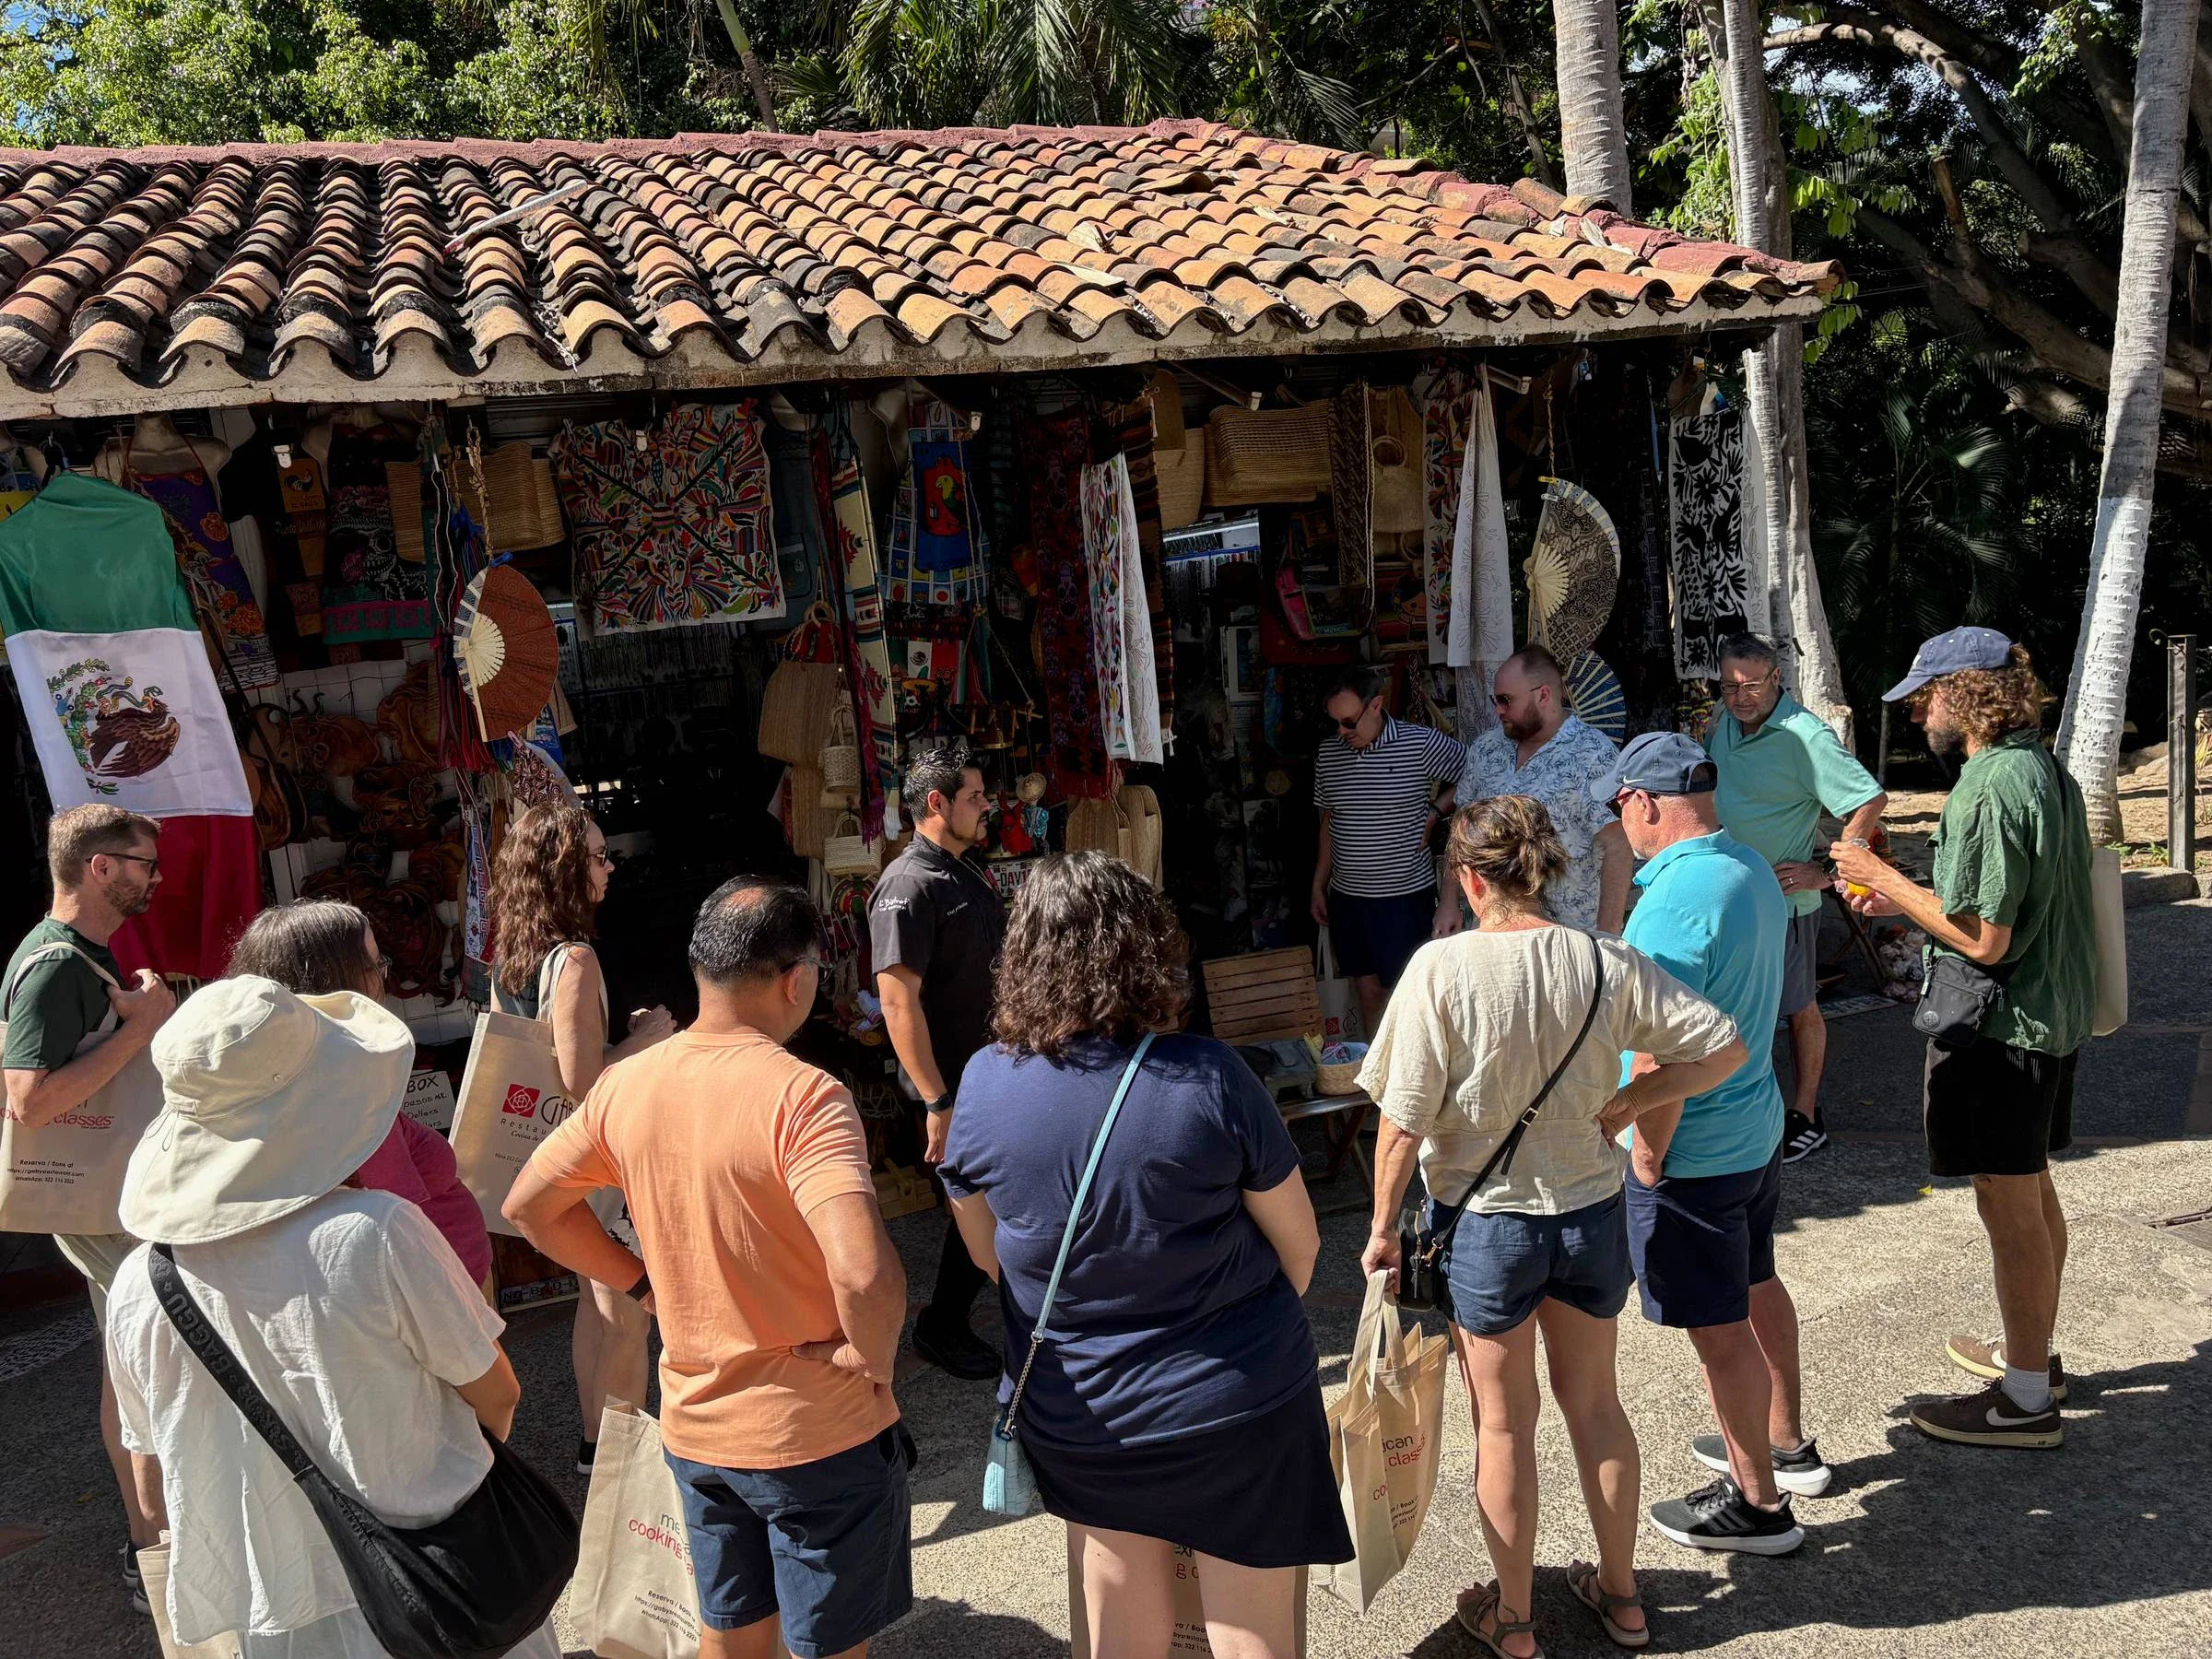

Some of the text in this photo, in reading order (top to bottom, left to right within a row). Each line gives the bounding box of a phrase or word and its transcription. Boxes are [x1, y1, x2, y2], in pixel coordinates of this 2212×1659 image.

[406, 1076, 439, 1093] BOX
[404, 1097, 433, 1110] pesos
[500, 1118, 547, 1135] Restau
[166, 1293, 230, 1376] BAGGU
[629, 1519, 682, 1559] cooking
